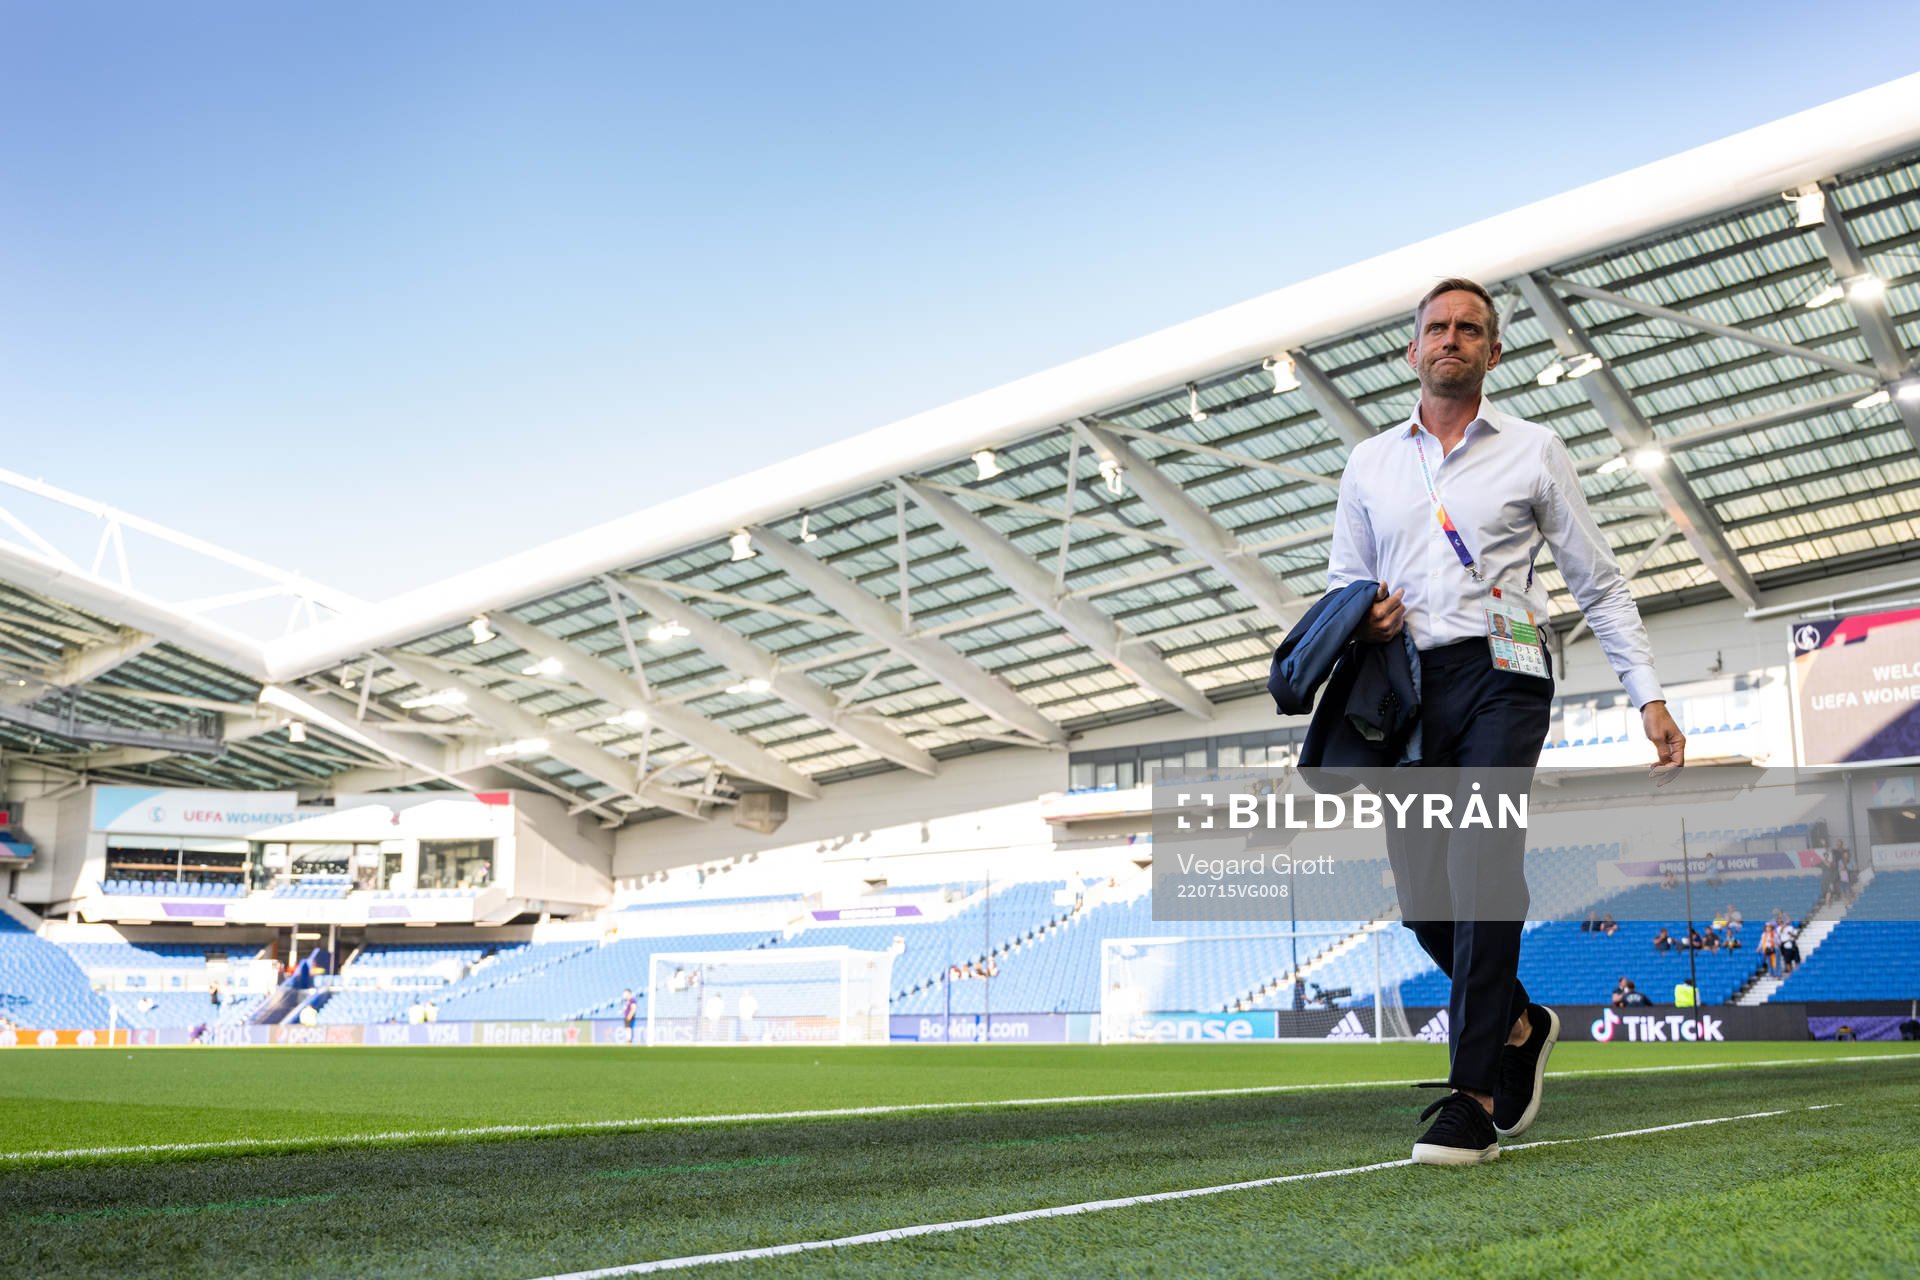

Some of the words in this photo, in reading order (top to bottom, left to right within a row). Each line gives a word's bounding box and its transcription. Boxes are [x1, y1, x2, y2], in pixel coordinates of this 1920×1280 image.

[1811, 692, 1859, 710] UEFA
[1862, 685, 1920, 704] WOME
[184, 810, 222, 823] UEFA
[1727, 857, 1759, 870] HOVE
[378, 1024, 410, 1043] VISA
[427, 1023, 460, 1043] VISA
[483, 1023, 562, 1043] Heineken
[1622, 1015, 1725, 1042] TikTok
